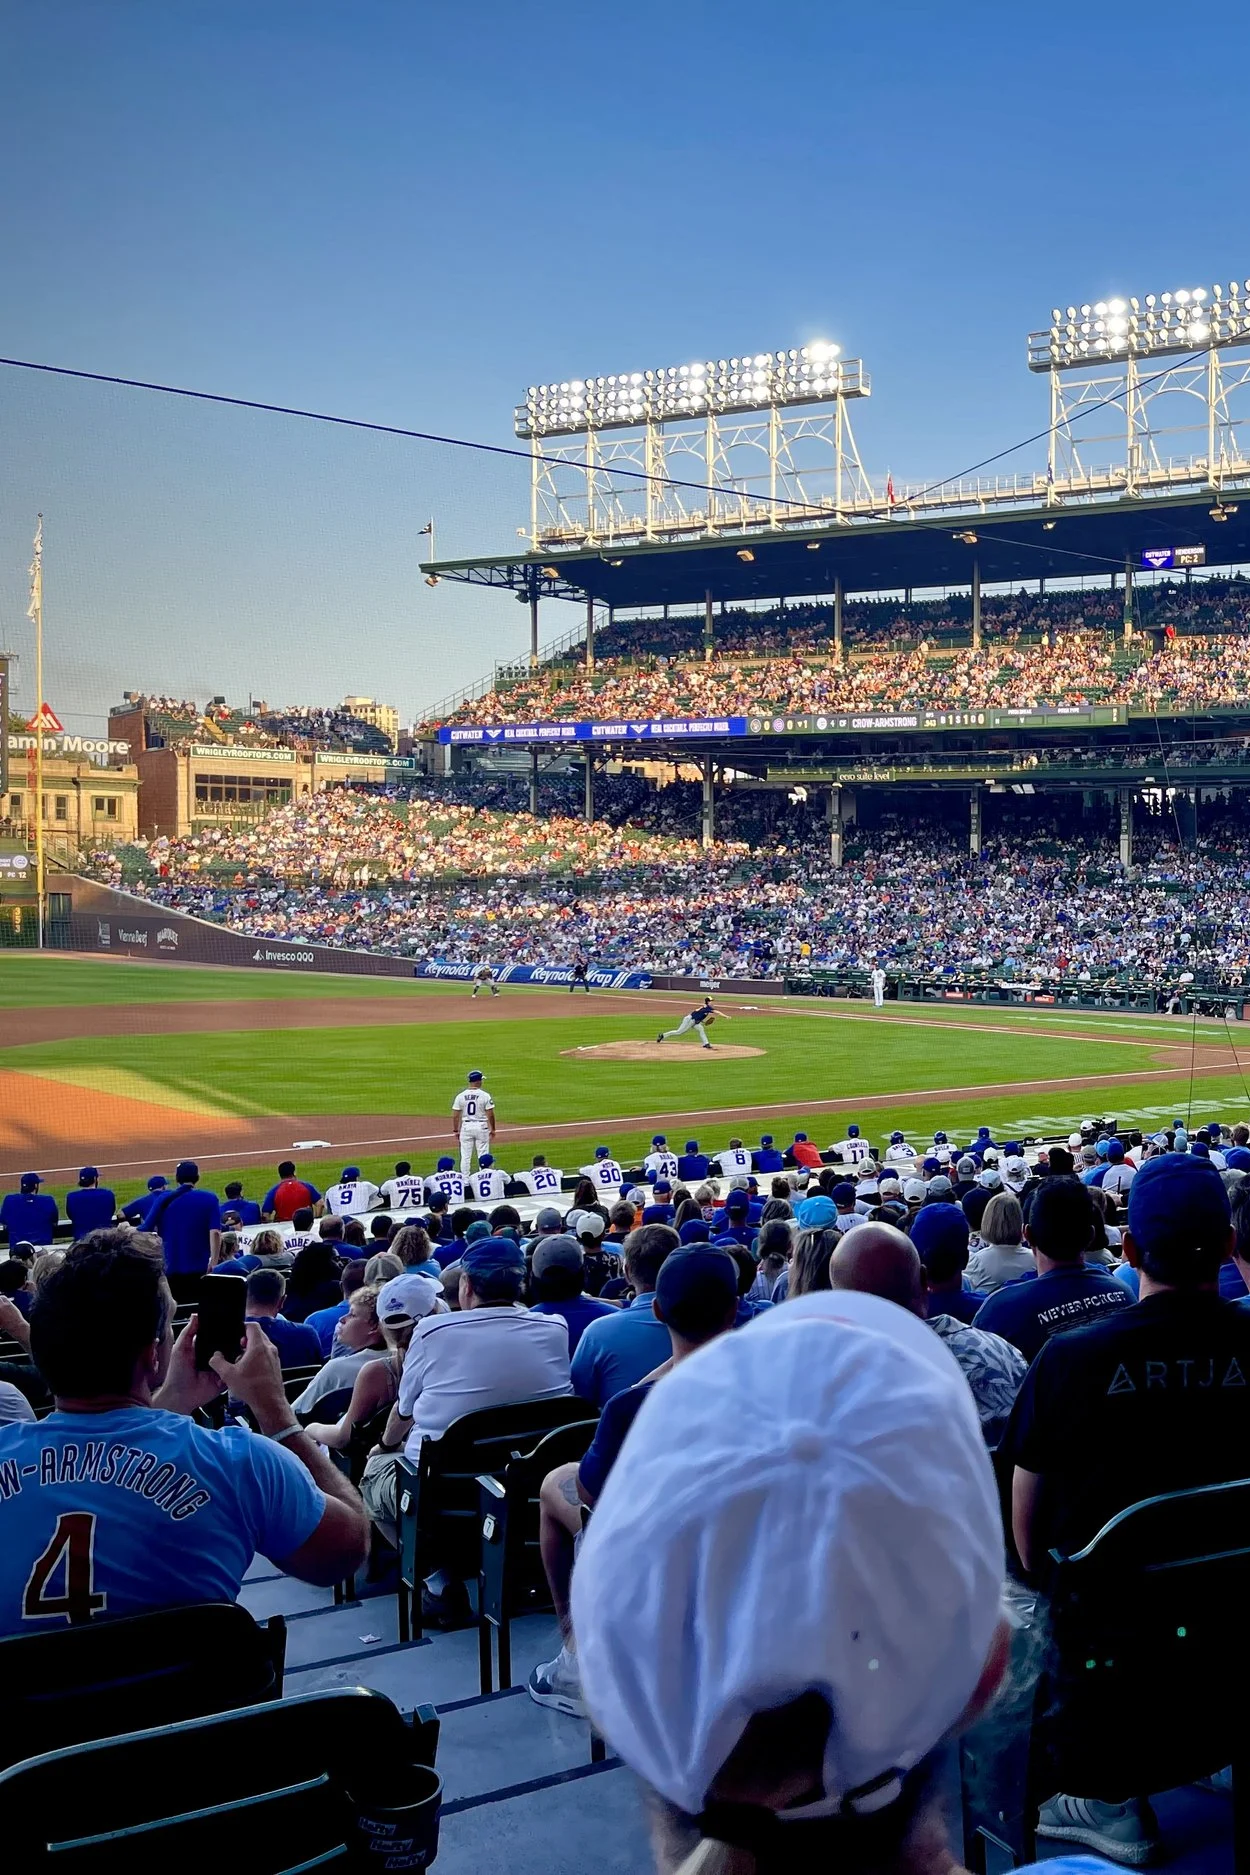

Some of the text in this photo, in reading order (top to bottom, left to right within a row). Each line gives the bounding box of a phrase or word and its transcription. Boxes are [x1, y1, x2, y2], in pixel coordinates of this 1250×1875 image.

[1193, 554, 1199, 563] 2
[592, 725, 628, 735] CUTWATER
[852, 717, 917, 728] CROW-ARMSTRONG
[451, 730, 483, 740] CUTWATER
[63, 736, 129, 754] Moore
[196, 747, 292, 761] WRIGLEYROOFTOPS.COM
[320, 754, 409, 767] WRIGLEYROOFTOPS.COM
[857, 771, 873, 780] suite
[873, 771, 890, 780] level
[265, 950, 314, 963] Invesco QQQ
[424, 962, 470, 978] Reynolds
[467, 1101, 476, 1116] 0
[735, 1153, 746, 1165] 8
[851, 1150, 865, 1164] 11
[599, 1168, 621, 1184] 90
[660, 1161, 677, 1178] 43
[440, 1181, 463, 1197] 83
[534, 1173, 558, 1190] 20
[479, 1181, 491, 1198] 6
[340, 1190, 353, 1205] 9
[398, 1189, 422, 1207] 75
[1037, 1299, 1083, 1326] NEVER
[1084, 1290, 1127, 1310] FORGET
[21, 1511, 108, 1625] 4
